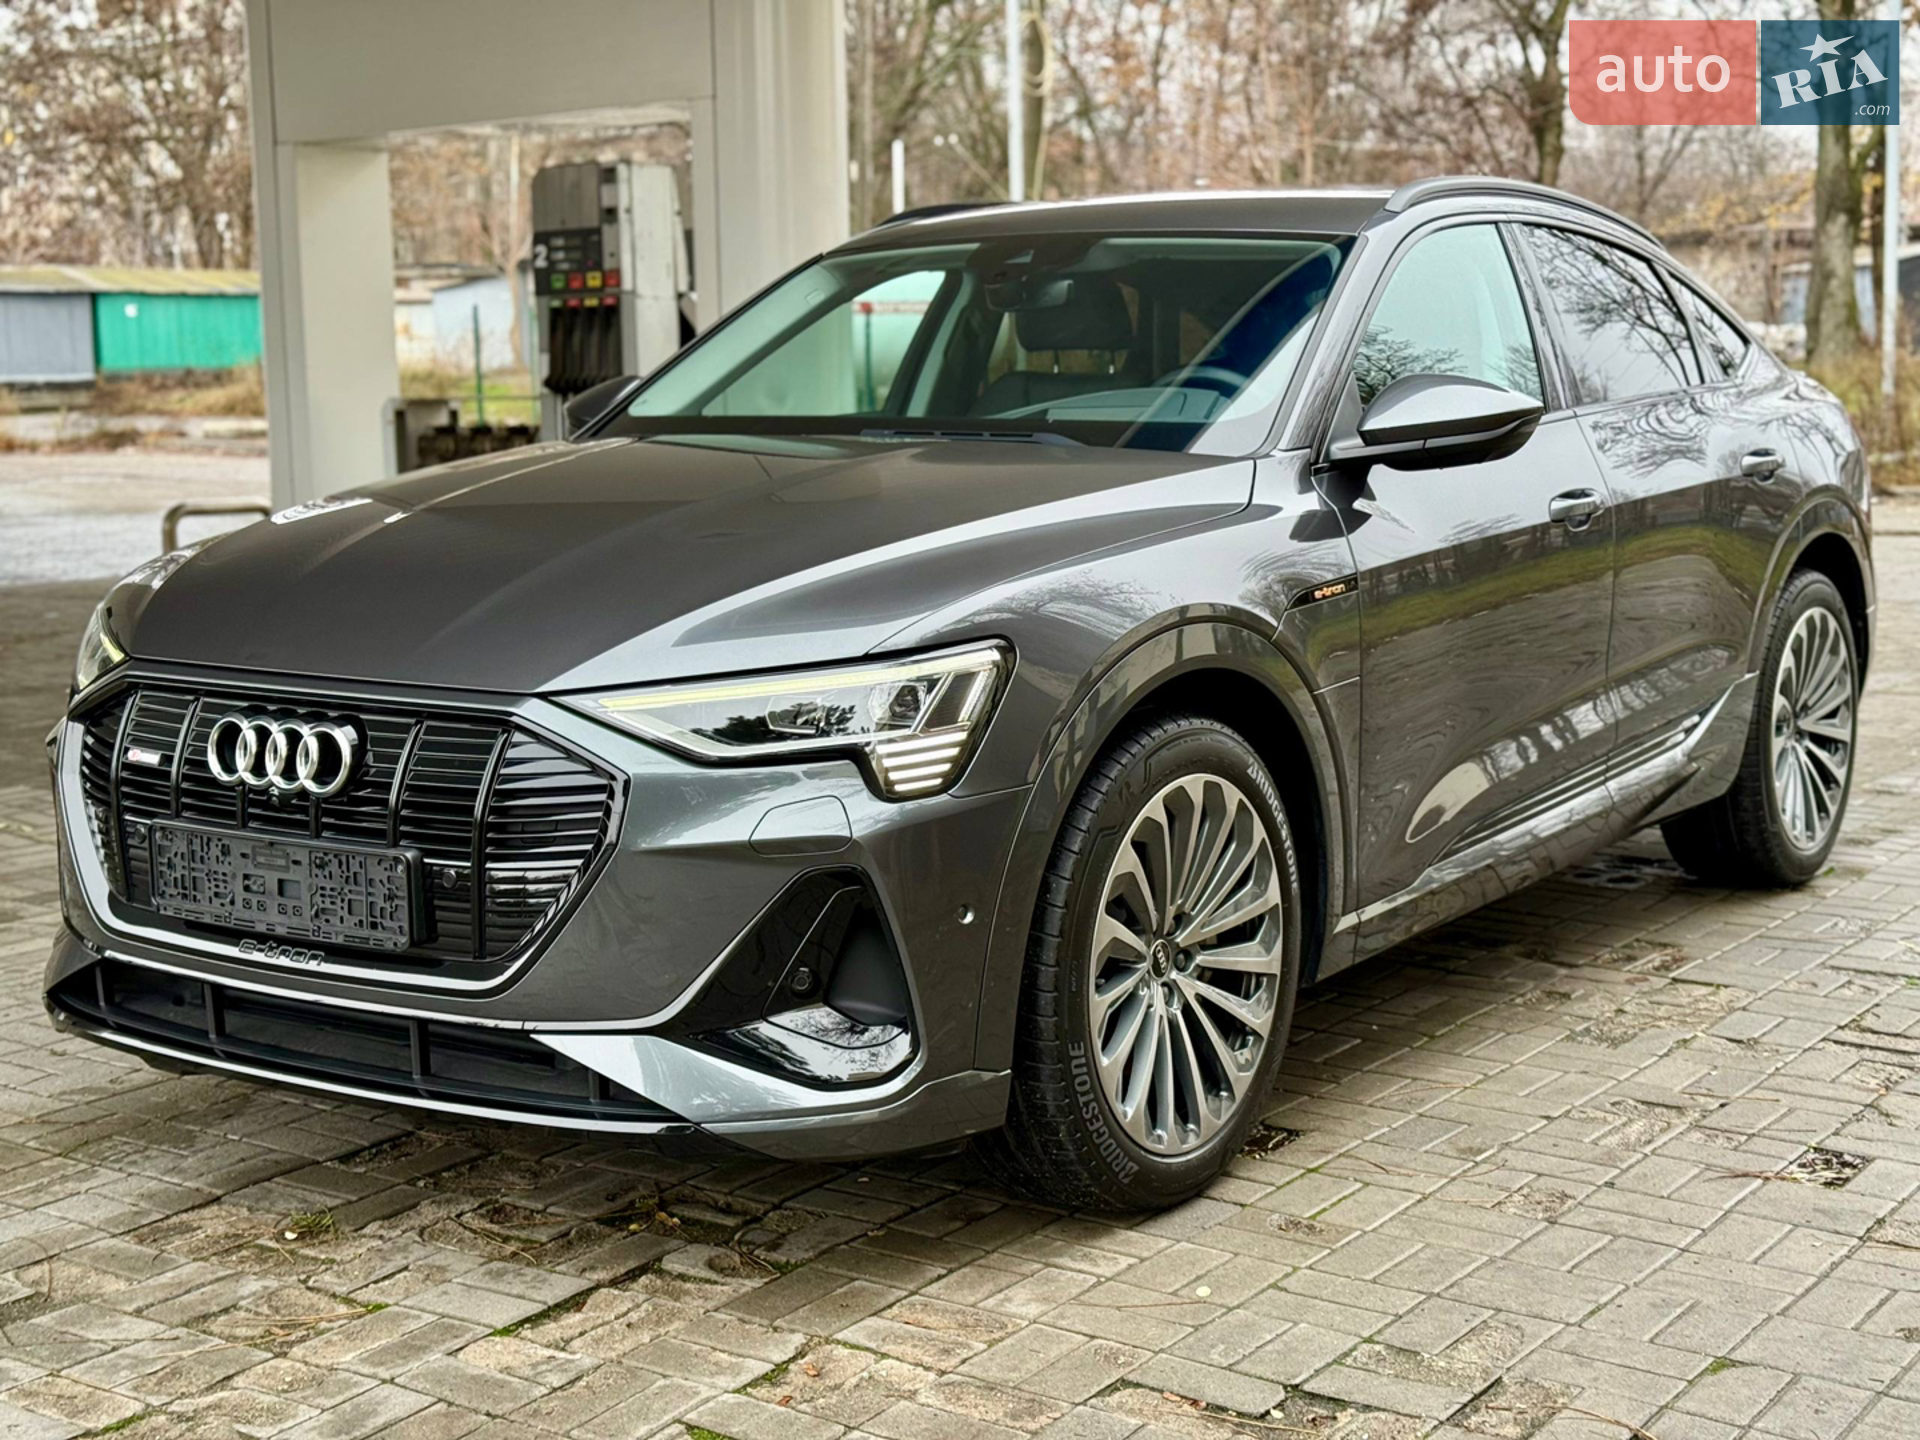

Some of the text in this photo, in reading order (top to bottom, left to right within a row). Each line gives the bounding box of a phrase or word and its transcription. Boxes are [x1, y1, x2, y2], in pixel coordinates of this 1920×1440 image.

[534, 244, 549, 269] 2
[1314, 583, 1346, 599] e-tron
[1247, 758, 1299, 896] BRIDGESTONE
[238, 938, 325, 966] e-tron
[1068, 1041, 1140, 1184] BRIDGESTONE
